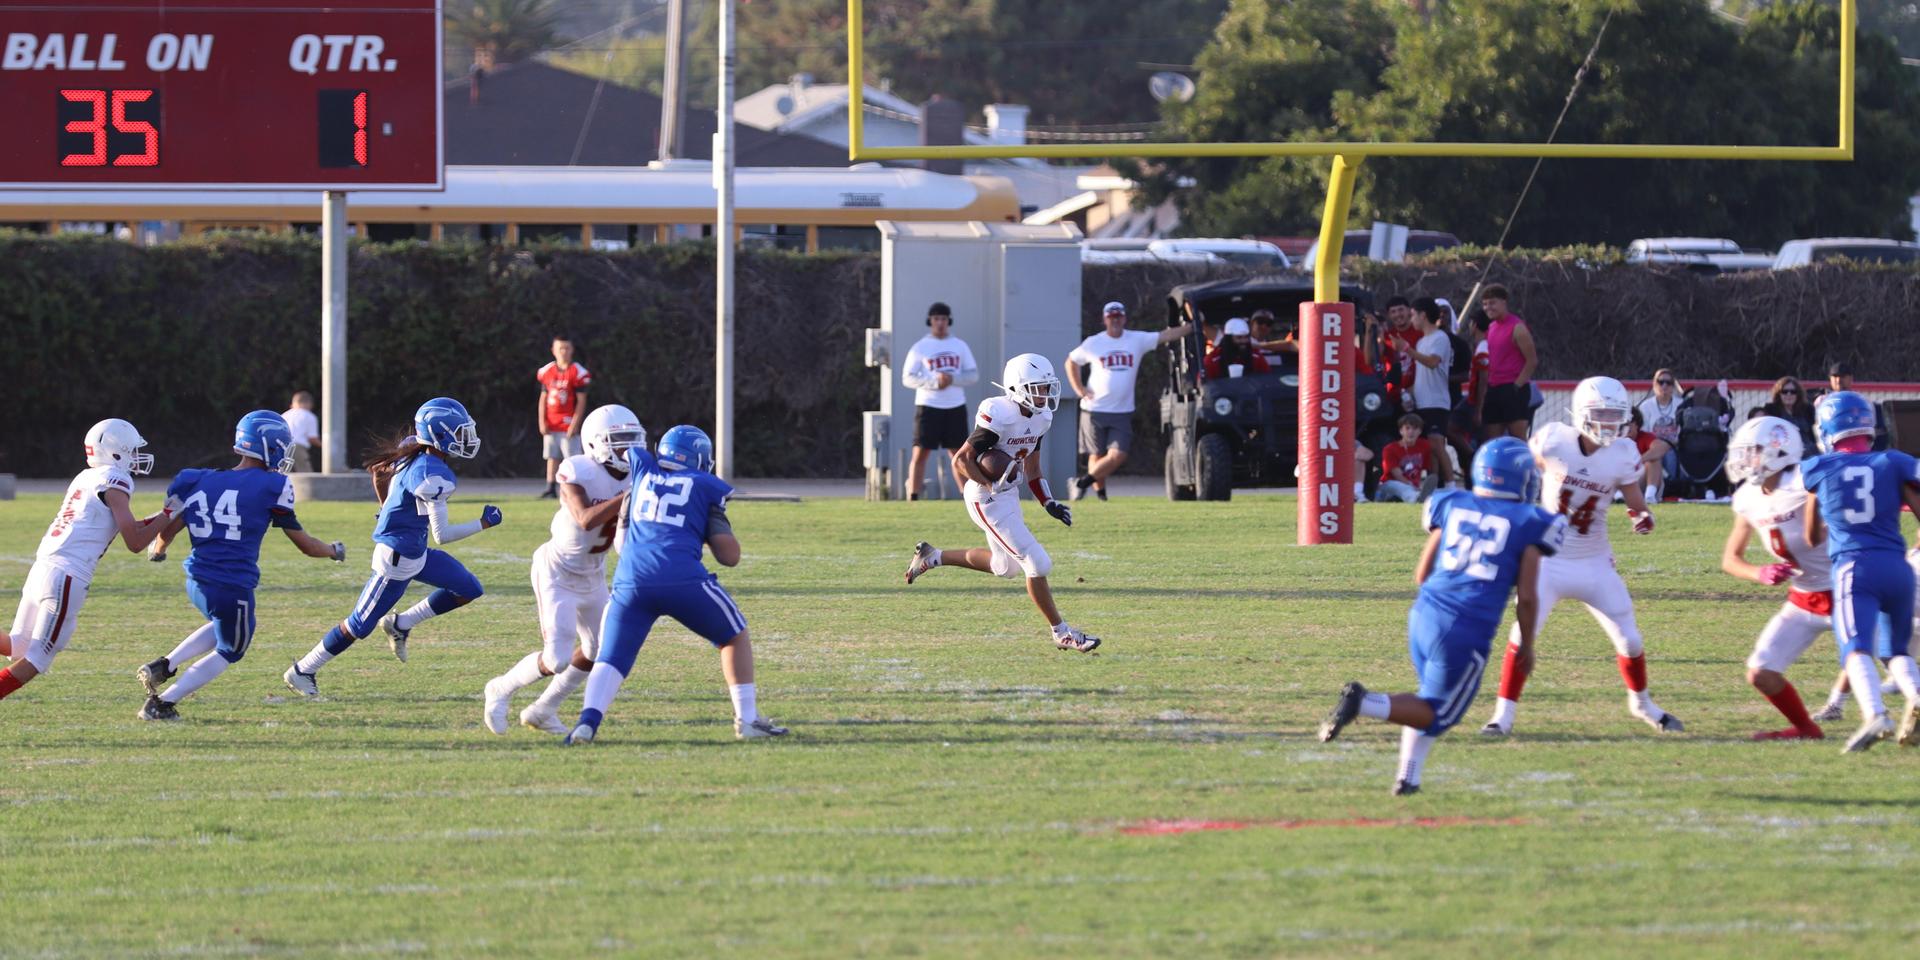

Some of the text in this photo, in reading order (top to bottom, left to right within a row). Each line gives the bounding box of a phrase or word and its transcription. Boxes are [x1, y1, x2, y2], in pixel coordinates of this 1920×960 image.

[2, 33, 214, 71] BALL ON
[289, 34, 398, 75] QTR.
[60, 89, 159, 166] 35
[353, 92, 368, 166] 1
[1319, 312, 1342, 535] REDSKINS
[184, 489, 242, 541] 34
[431, 486, 444, 500] 1
[633, 472, 694, 528] 62
[1558, 488, 1601, 535] 14
[1843, 466, 1876, 524] 3
[1442, 507, 1511, 581] 52
